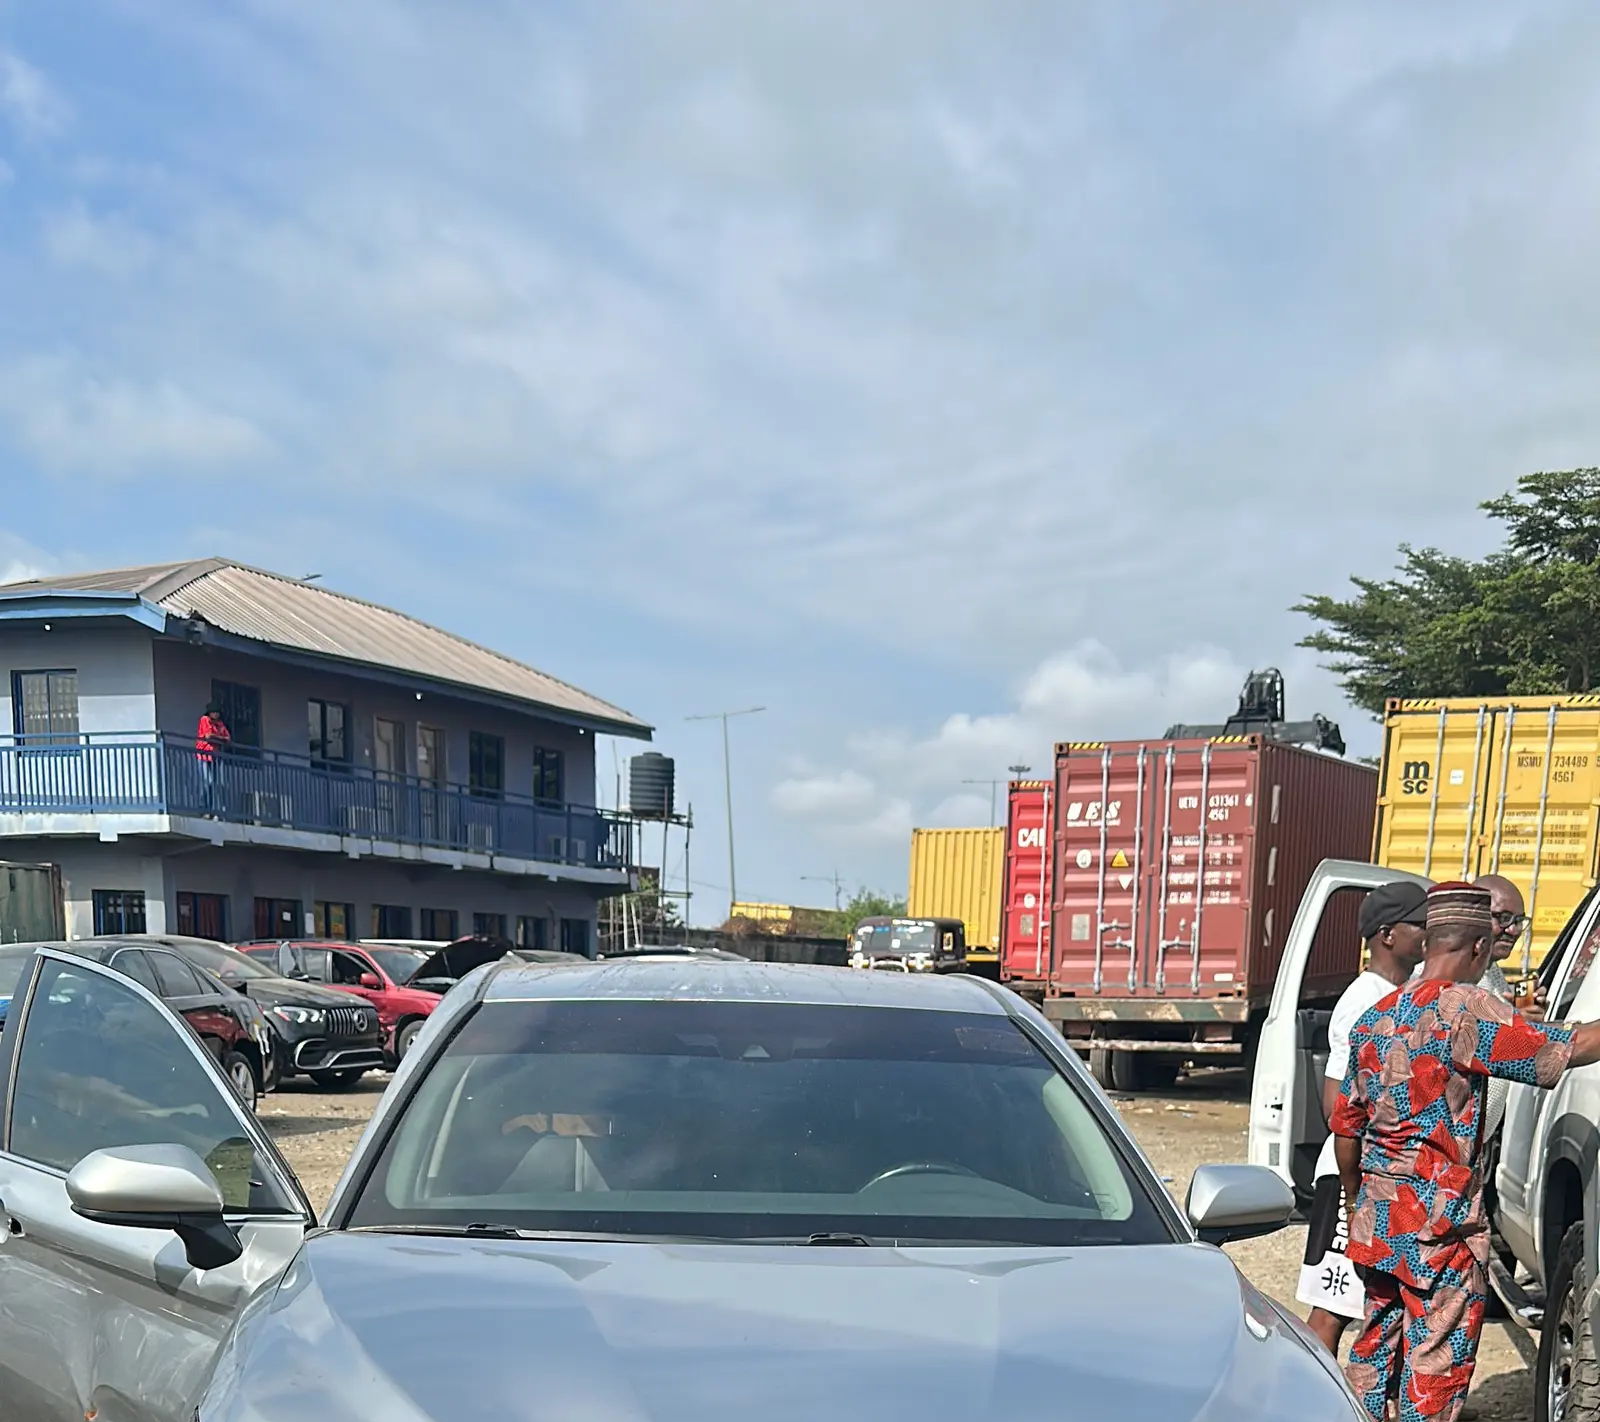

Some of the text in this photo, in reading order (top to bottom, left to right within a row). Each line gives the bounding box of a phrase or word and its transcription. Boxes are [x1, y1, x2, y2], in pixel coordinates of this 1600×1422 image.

[1517, 756, 1542, 768] MSMU
[1554, 756, 1588, 768] 734489
[1552, 771, 1575, 783] 45G1
